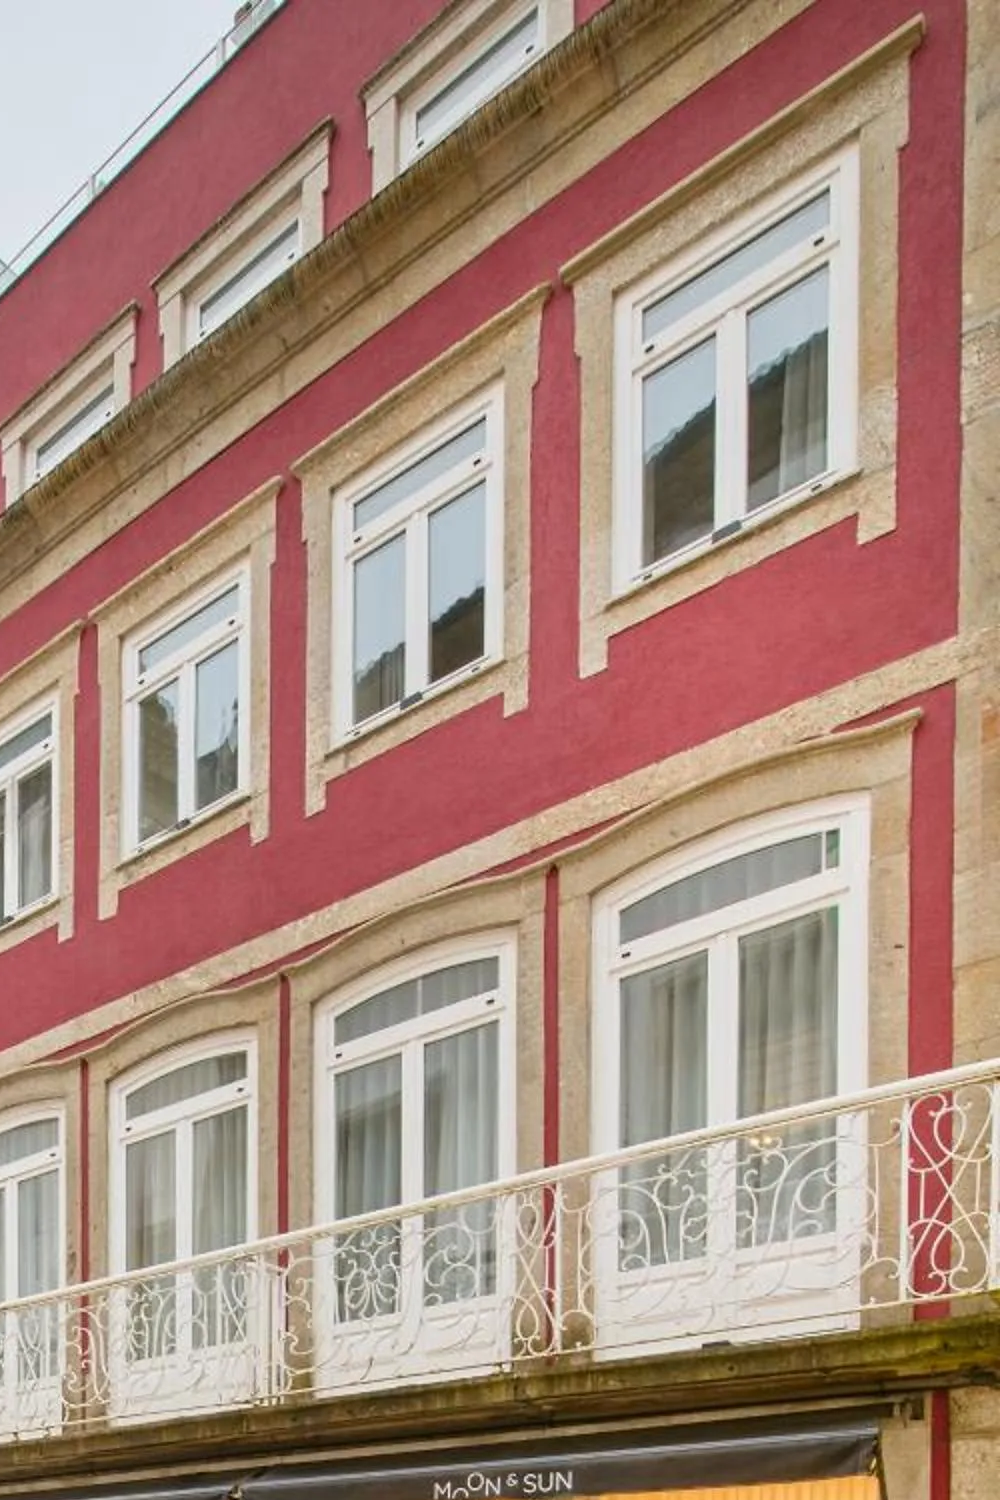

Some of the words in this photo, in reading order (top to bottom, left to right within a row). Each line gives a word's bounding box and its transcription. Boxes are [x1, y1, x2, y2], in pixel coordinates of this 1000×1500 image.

[433, 1471, 501, 1500] MOON
[505, 1472, 519, 1487] &
[523, 1470, 573, 1494] SUN
